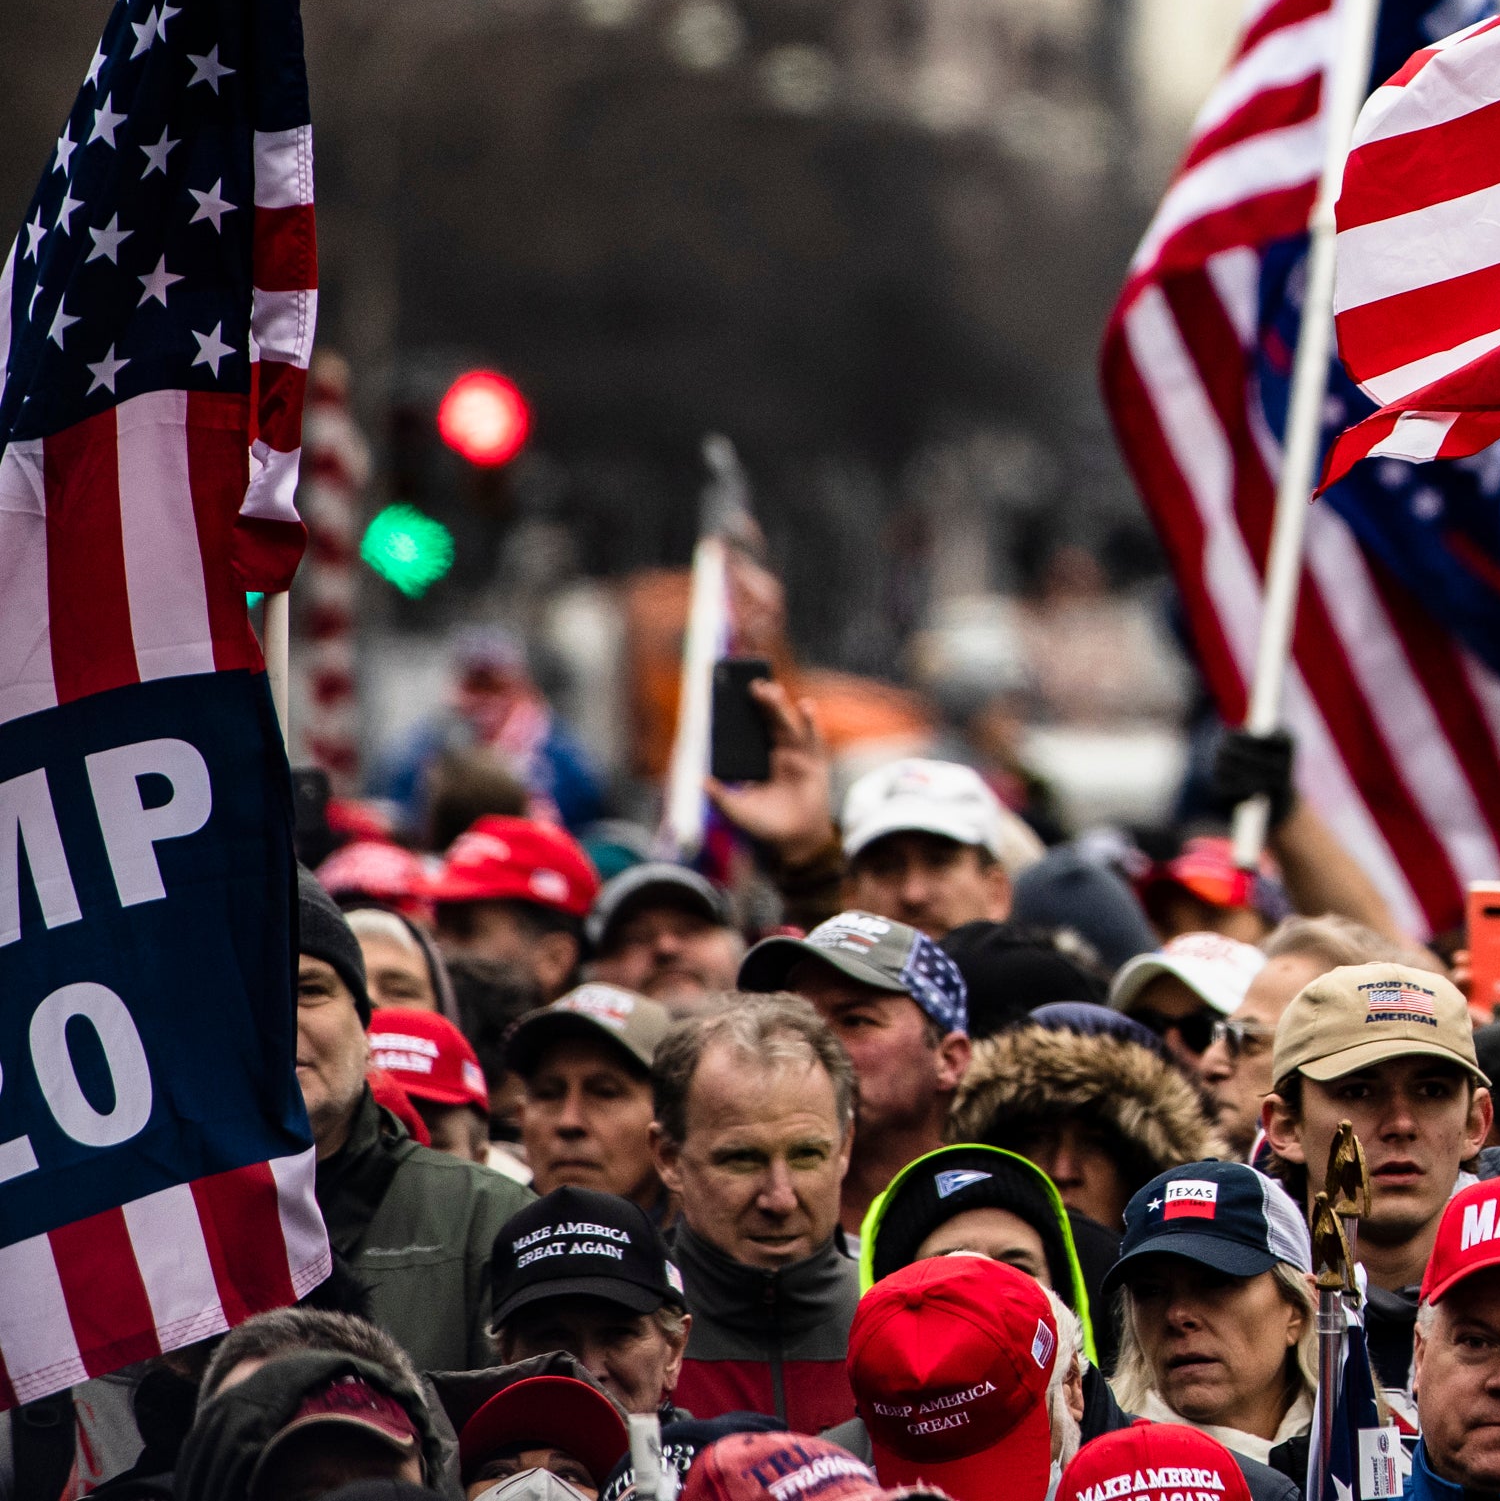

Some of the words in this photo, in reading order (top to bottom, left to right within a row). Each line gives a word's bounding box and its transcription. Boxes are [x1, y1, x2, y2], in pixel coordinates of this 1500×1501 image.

[1357, 981, 1402, 991] PROUD
[1365, 1012, 1438, 1028] AMERICAN
[1168, 1187, 1213, 1199] TEXAS
[512, 1224, 552, 1253] MAKE
[554, 1221, 632, 1244] AMERICA
[516, 1241, 567, 1270] GREAT
[569, 1240, 624, 1261] AGAIN
[873, 1402, 913, 1417] KEEP
[919, 1380, 998, 1415] AMERICA
[907, 1411, 971, 1436] GREAT!
[1076, 1474, 1132, 1501] MAKE
[1132, 1467, 1226, 1492] AMERICA
